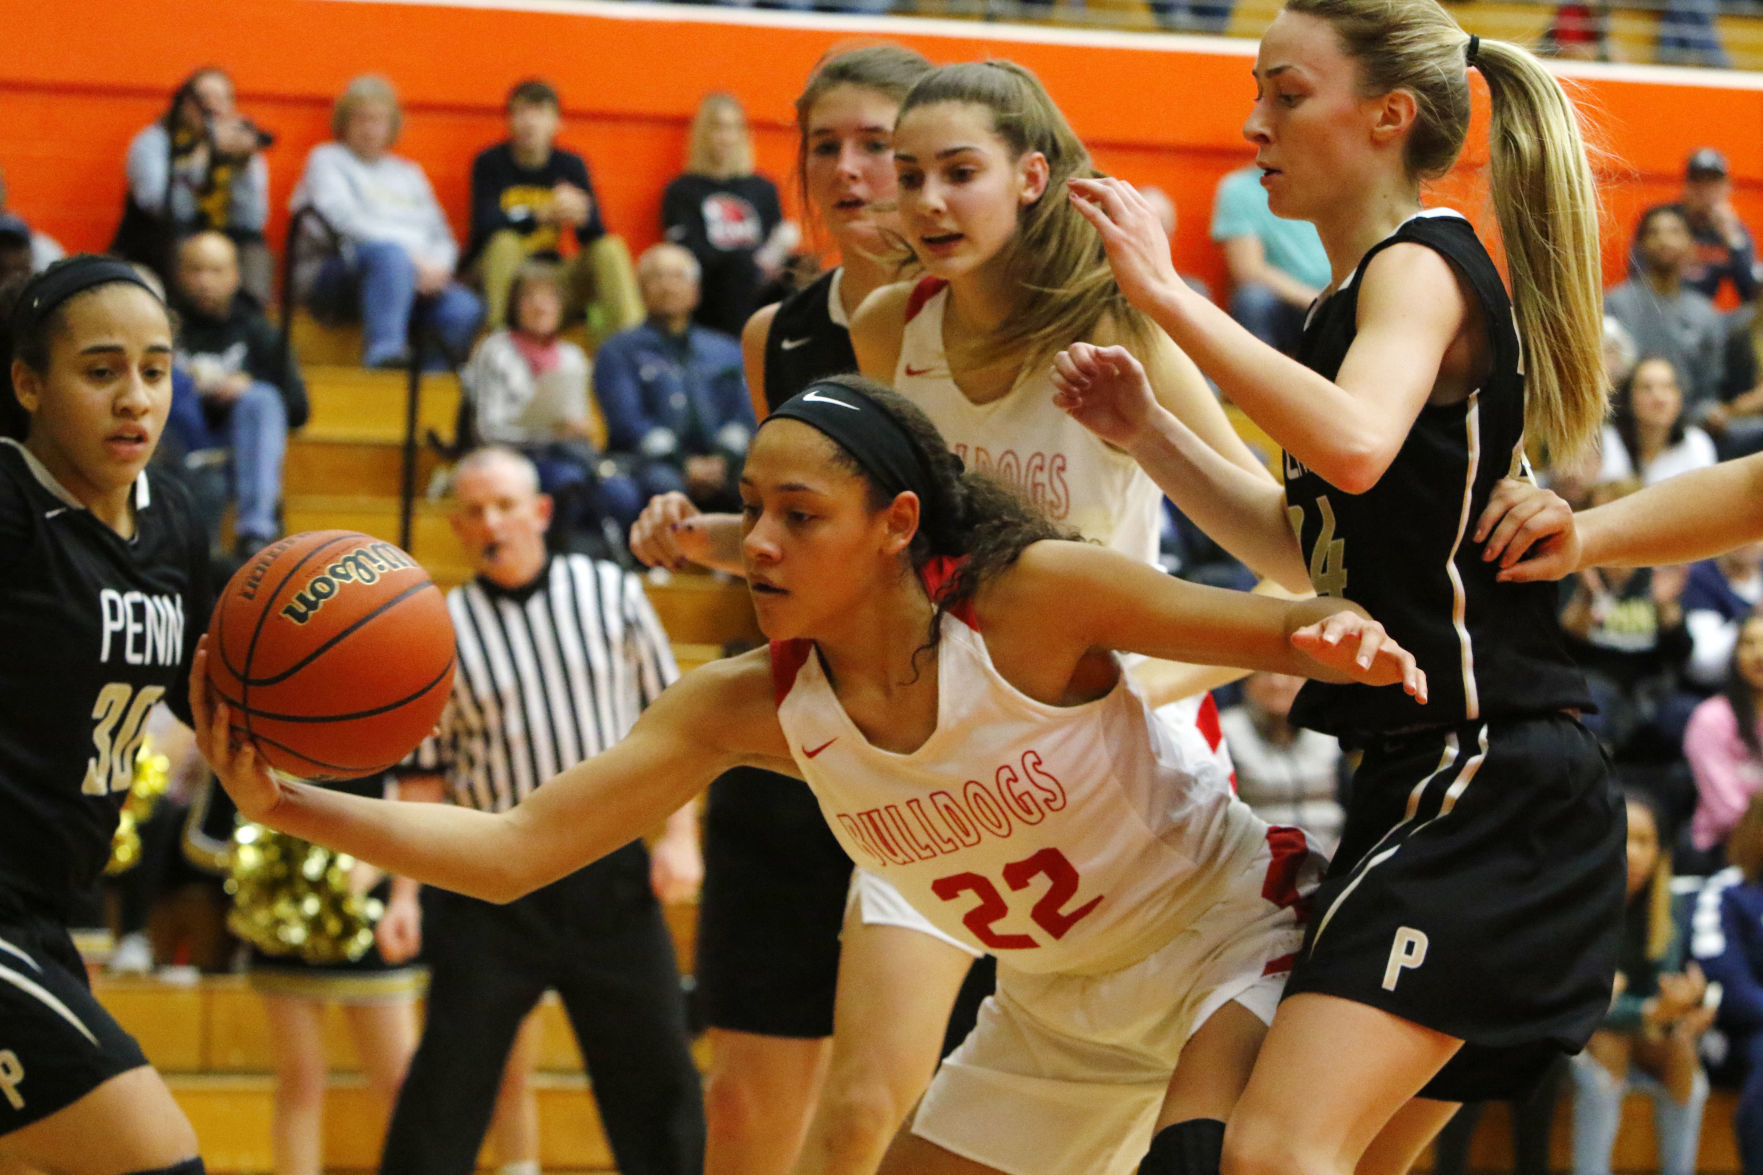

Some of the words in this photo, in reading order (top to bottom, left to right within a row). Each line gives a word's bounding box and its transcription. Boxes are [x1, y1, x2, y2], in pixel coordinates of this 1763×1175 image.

[280, 541, 418, 625] Wilson
[100, 588, 184, 666] PENN
[81, 682, 166, 796] 30
[837, 750, 1067, 867] BULLDOGS
[931, 847, 1104, 950] 22
[1381, 925, 1429, 992] P
[0, 1048, 25, 1111] P
